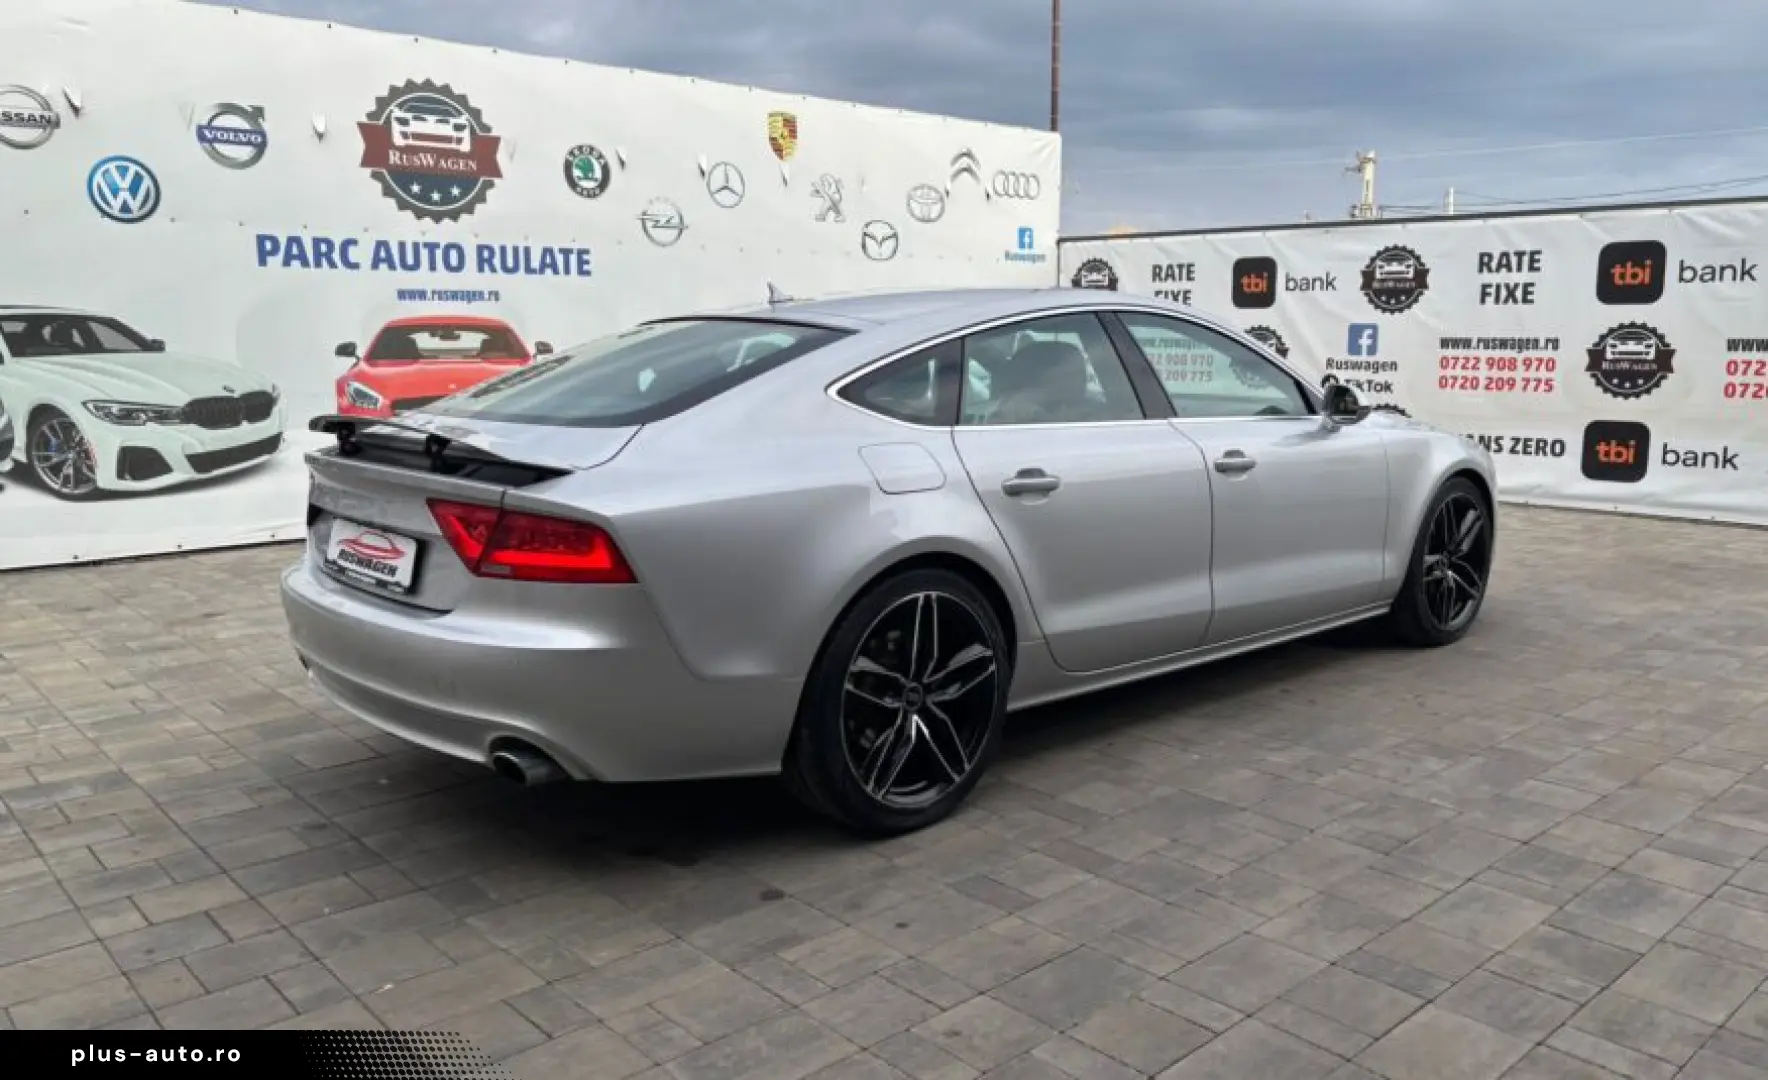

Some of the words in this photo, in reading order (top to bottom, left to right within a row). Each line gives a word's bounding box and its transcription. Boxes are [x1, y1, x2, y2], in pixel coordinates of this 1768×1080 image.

[202, 129, 261, 142] VOLVO
[255, 234, 361, 270] PARC
[371, 239, 466, 273] AUTO
[476, 243, 593, 277] RULATE
[1477, 250, 1543, 274] RATE
[1151, 263, 1196, 282] RATE
[1610, 259, 1653, 286] tbi
[1678, 258, 1759, 284] bank
[1241, 272, 1268, 293] tbi
[1285, 271, 1338, 292] bank
[396, 288, 501, 304] www.ruswagen.ro
[1479, 282, 1536, 305] FIXE
[1439, 337, 1560, 353] www.ruswagen.ro
[1325, 357, 1398, 373] Ruswagen
[1439, 356, 1481, 371] 0722
[1485, 357, 1518, 372] 908
[1522, 357, 1557, 373] 970
[1438, 375, 1480, 391] 0720
[1484, 376, 1517, 392] 209
[1521, 377, 1555, 393] 775
[1723, 381, 1768, 399] 072
[1509, 437, 1567, 457] ZERO
[1595, 440, 1636, 464] tbi
[1661, 444, 1740, 471] bank
